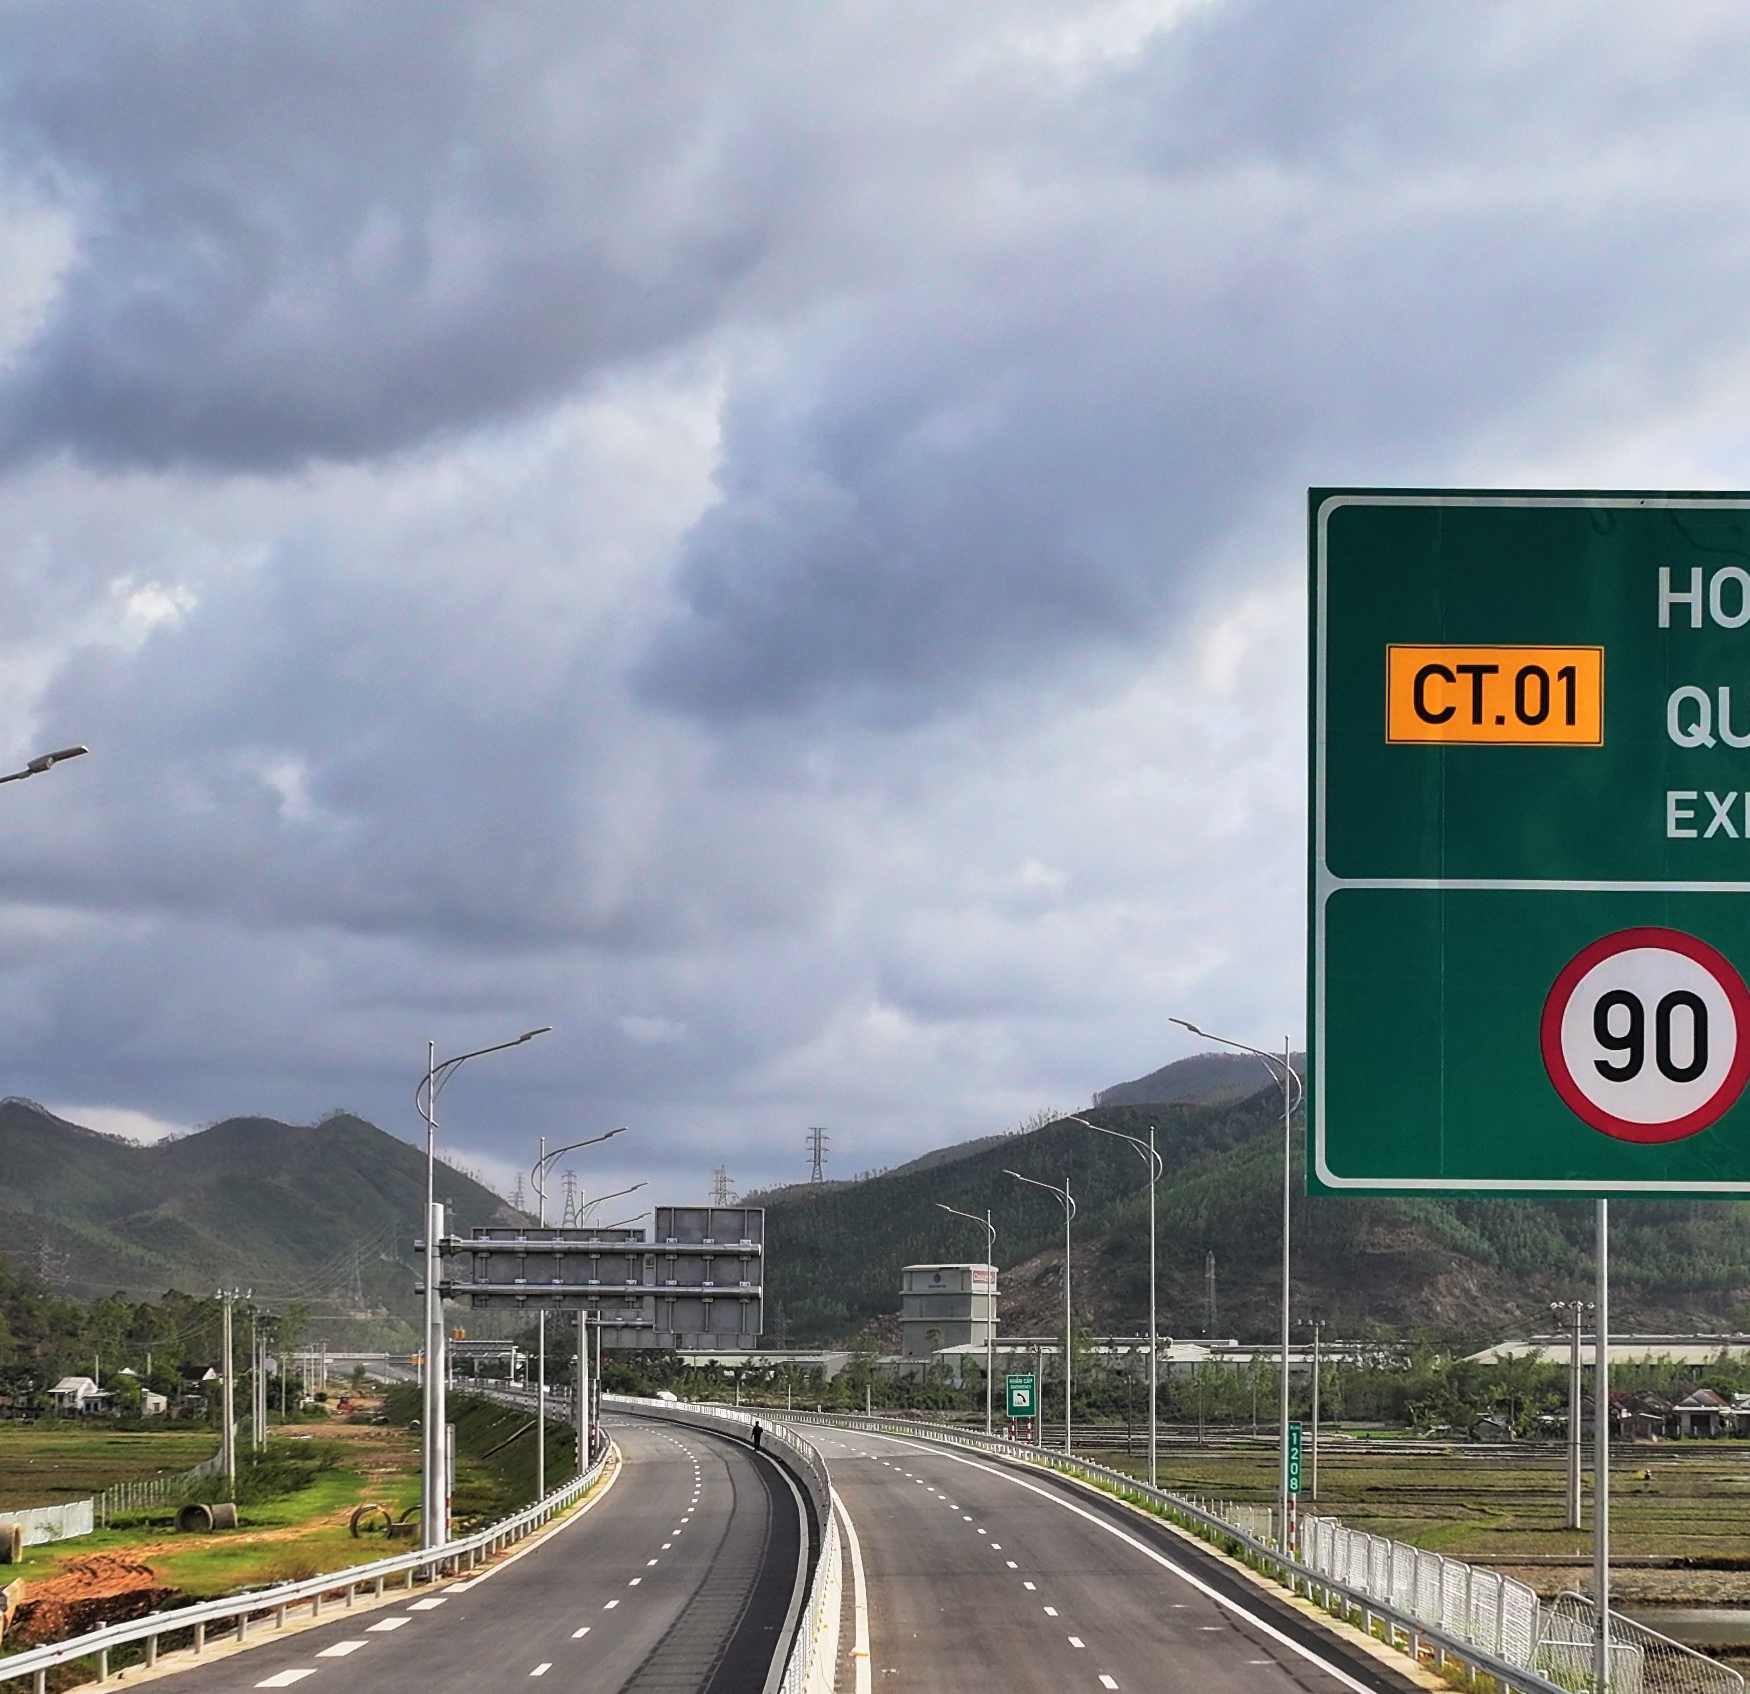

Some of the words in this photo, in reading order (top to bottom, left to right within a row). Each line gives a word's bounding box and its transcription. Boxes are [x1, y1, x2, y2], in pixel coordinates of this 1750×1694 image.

[1412, 662, 1577, 726] CT.01
[1593, 989, 1709, 1083] 90
[1290, 1432, 1299, 1490] 1208
